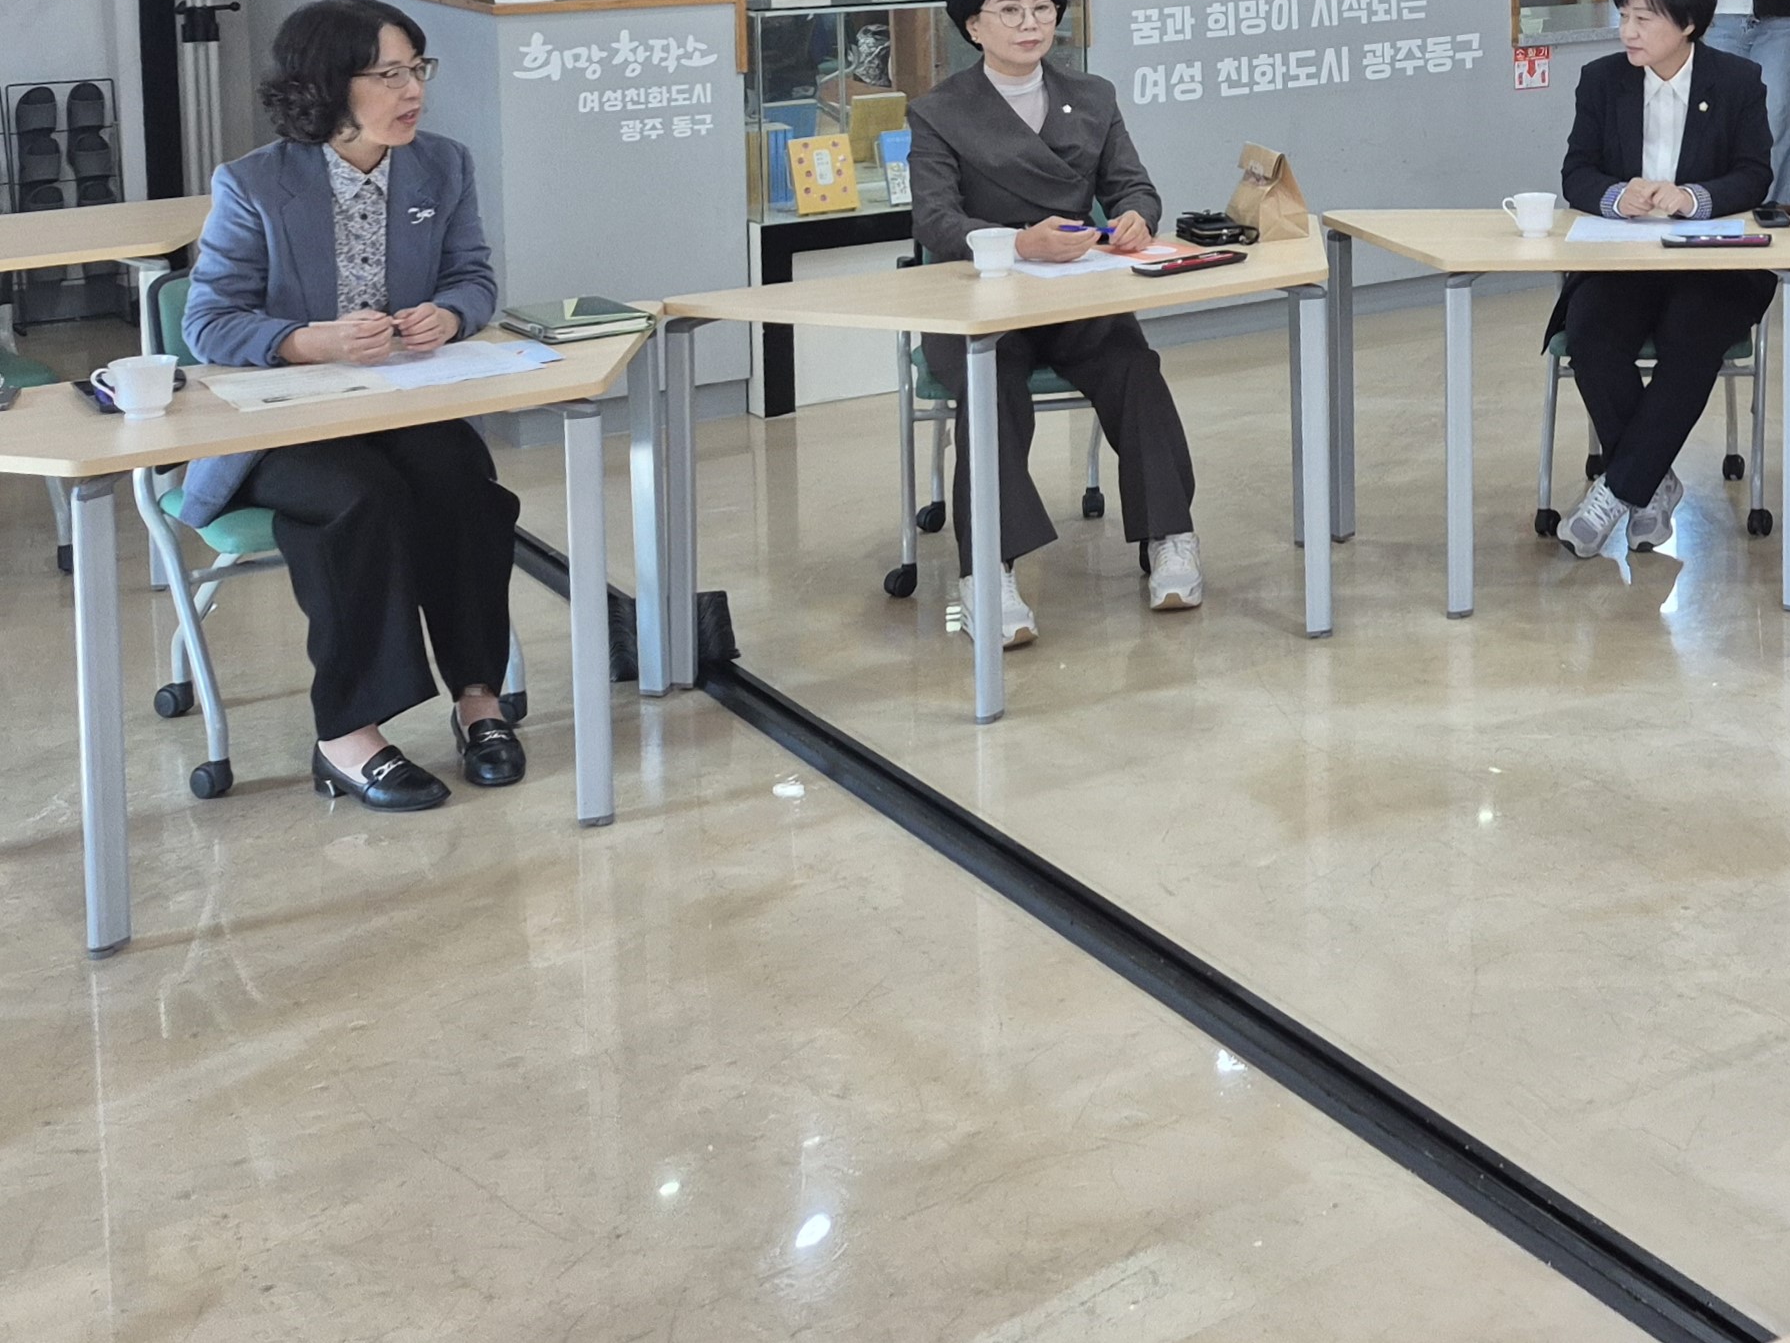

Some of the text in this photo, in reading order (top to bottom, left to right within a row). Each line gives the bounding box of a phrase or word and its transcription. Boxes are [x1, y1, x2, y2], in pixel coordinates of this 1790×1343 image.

[1130, 6, 1194, 46] 꿈과
[513, 29, 718, 81] 희망 창작소
[1133, 33, 1484, 105] 여성 친화도시 광주동구
[578, 83, 712, 113] 여성친화도시
[620, 114, 714, 142] 광주 동구
